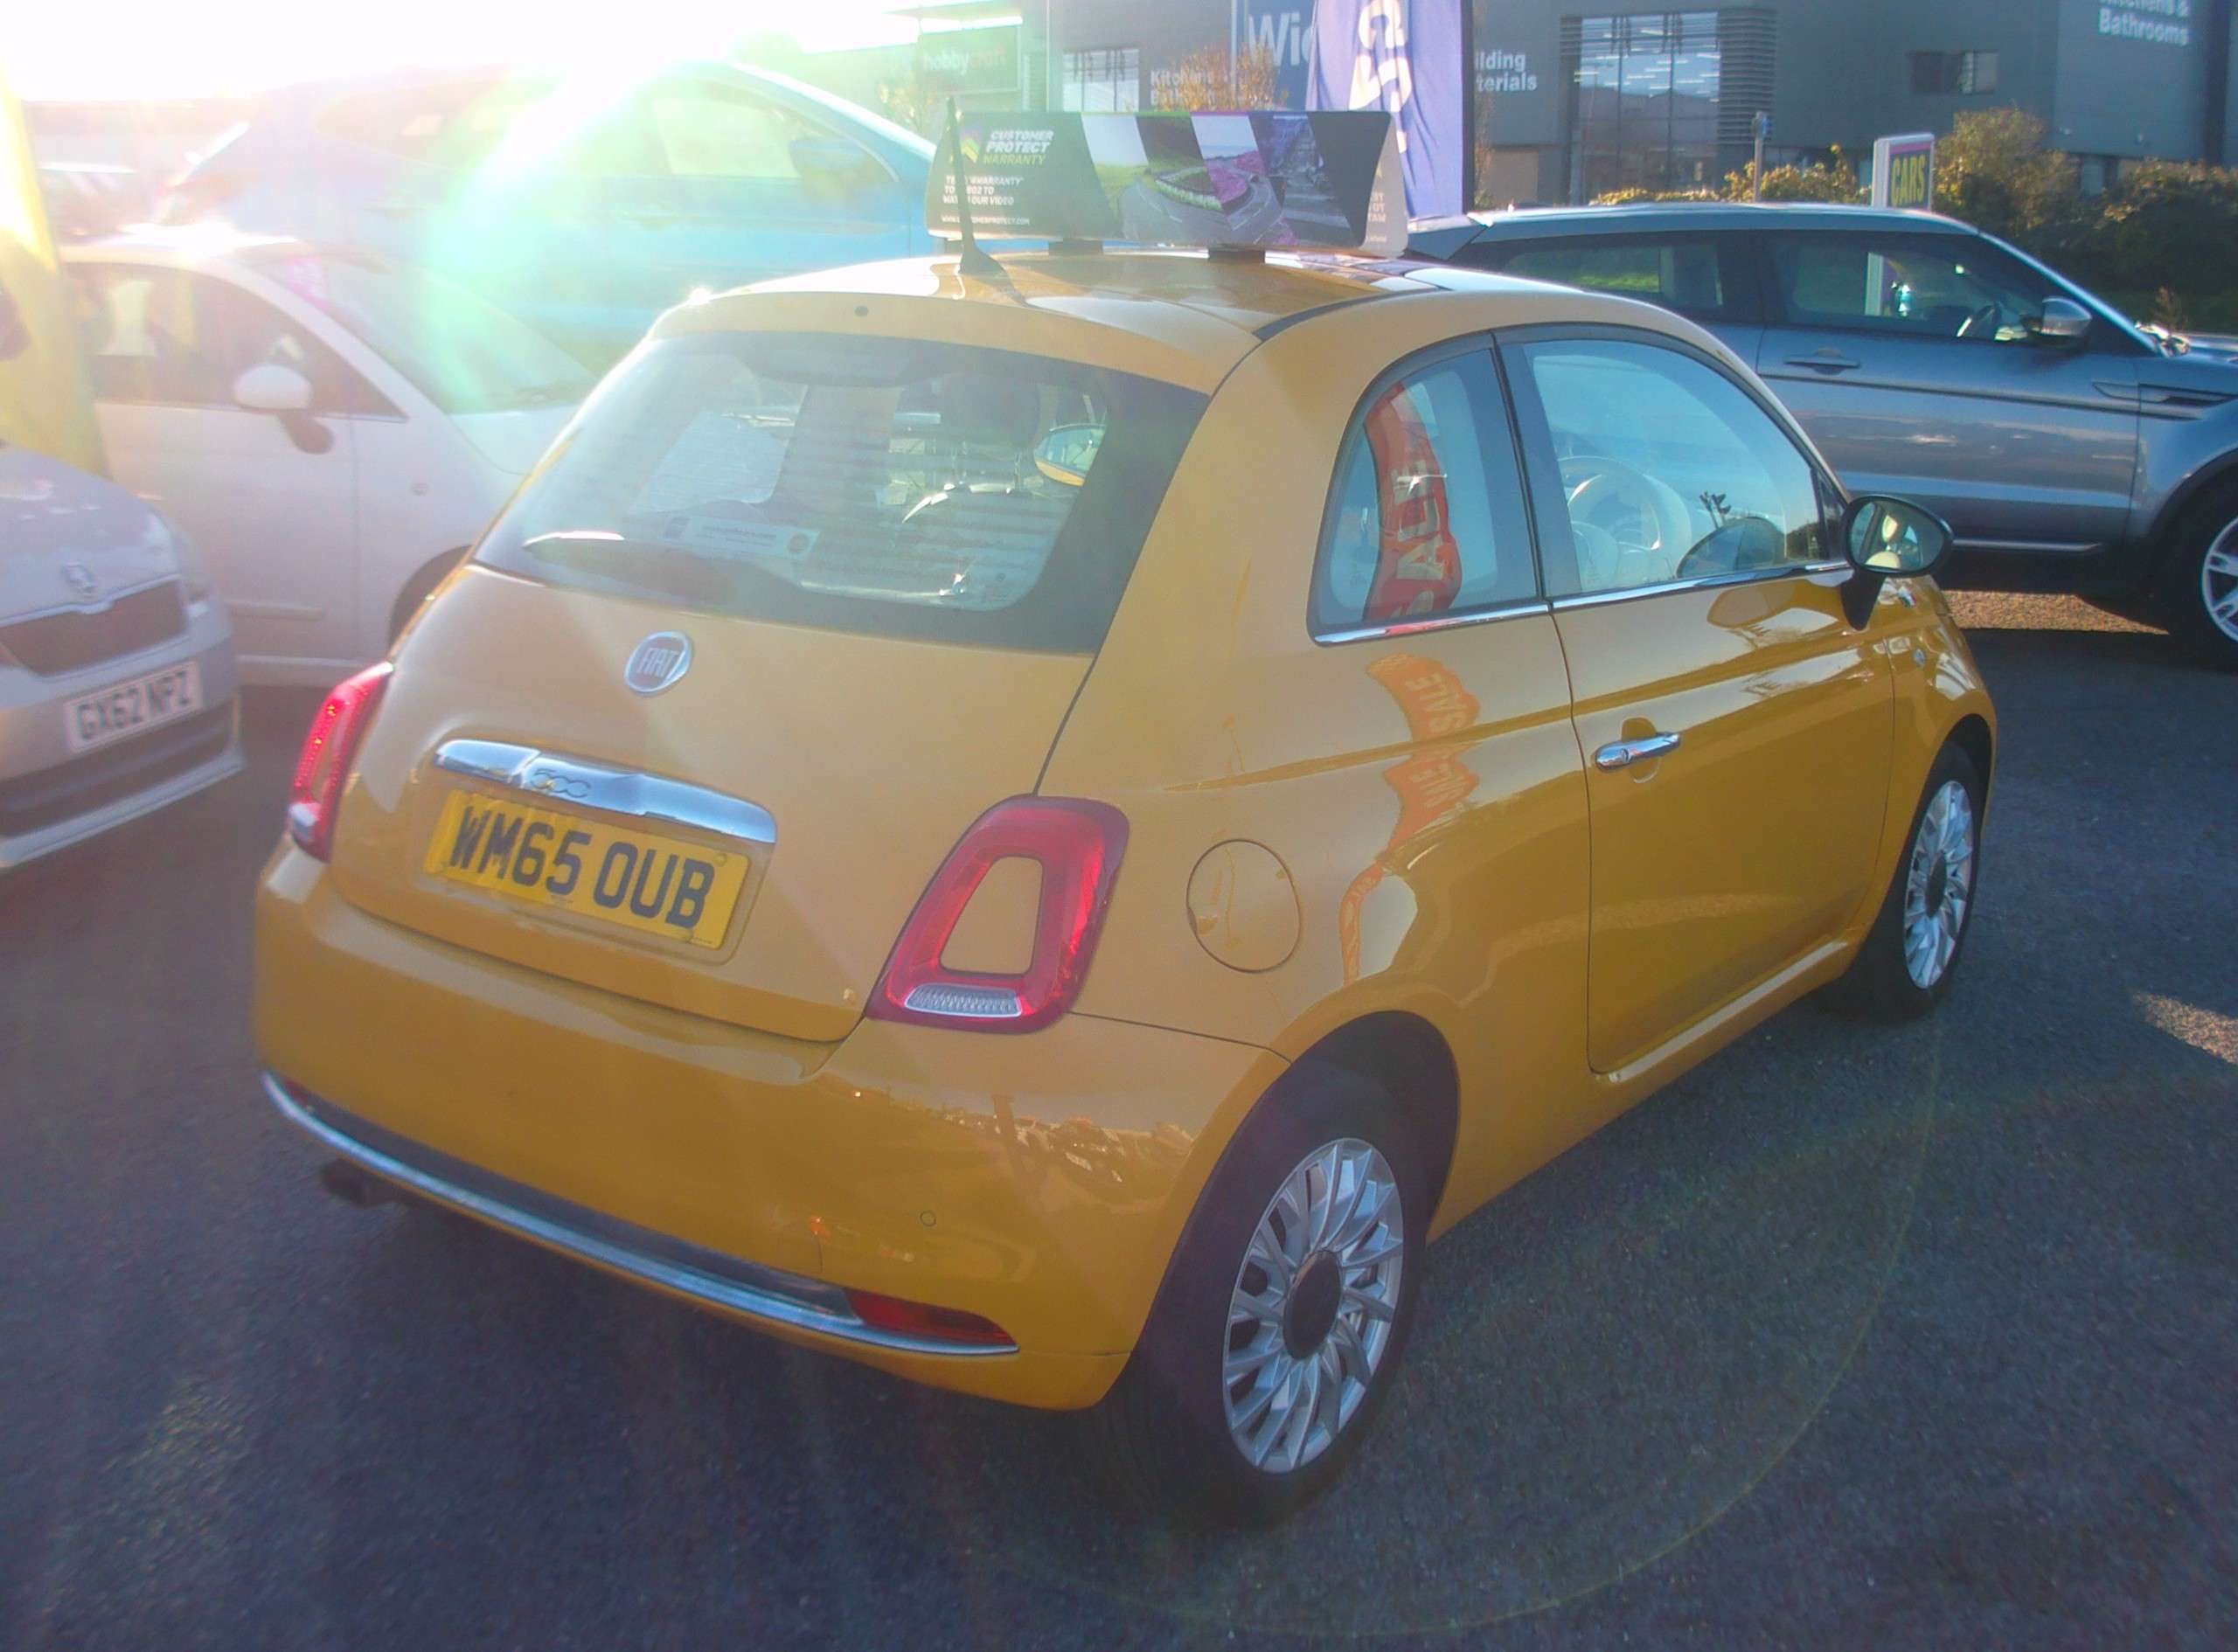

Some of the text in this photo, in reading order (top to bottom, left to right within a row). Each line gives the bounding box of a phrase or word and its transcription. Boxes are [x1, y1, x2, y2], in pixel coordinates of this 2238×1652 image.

[2099, 7, 2188, 47] Bathrooms
[1475, 50, 1526, 72] ilding
[1475, 72, 1539, 91] terials
[990, 130, 1054, 141] CUSTOMER
[985, 142, 1051, 154] PROTECT
[983, 154, 1046, 165] WARRANTY
[983, 185, 995, 194] TO
[1891, 154, 1926, 206] CARS
[990, 197, 1014, 205] VIDEO
[636, 647, 680, 677] FIAT
[449, 805, 716, 930] WM65 OUB
